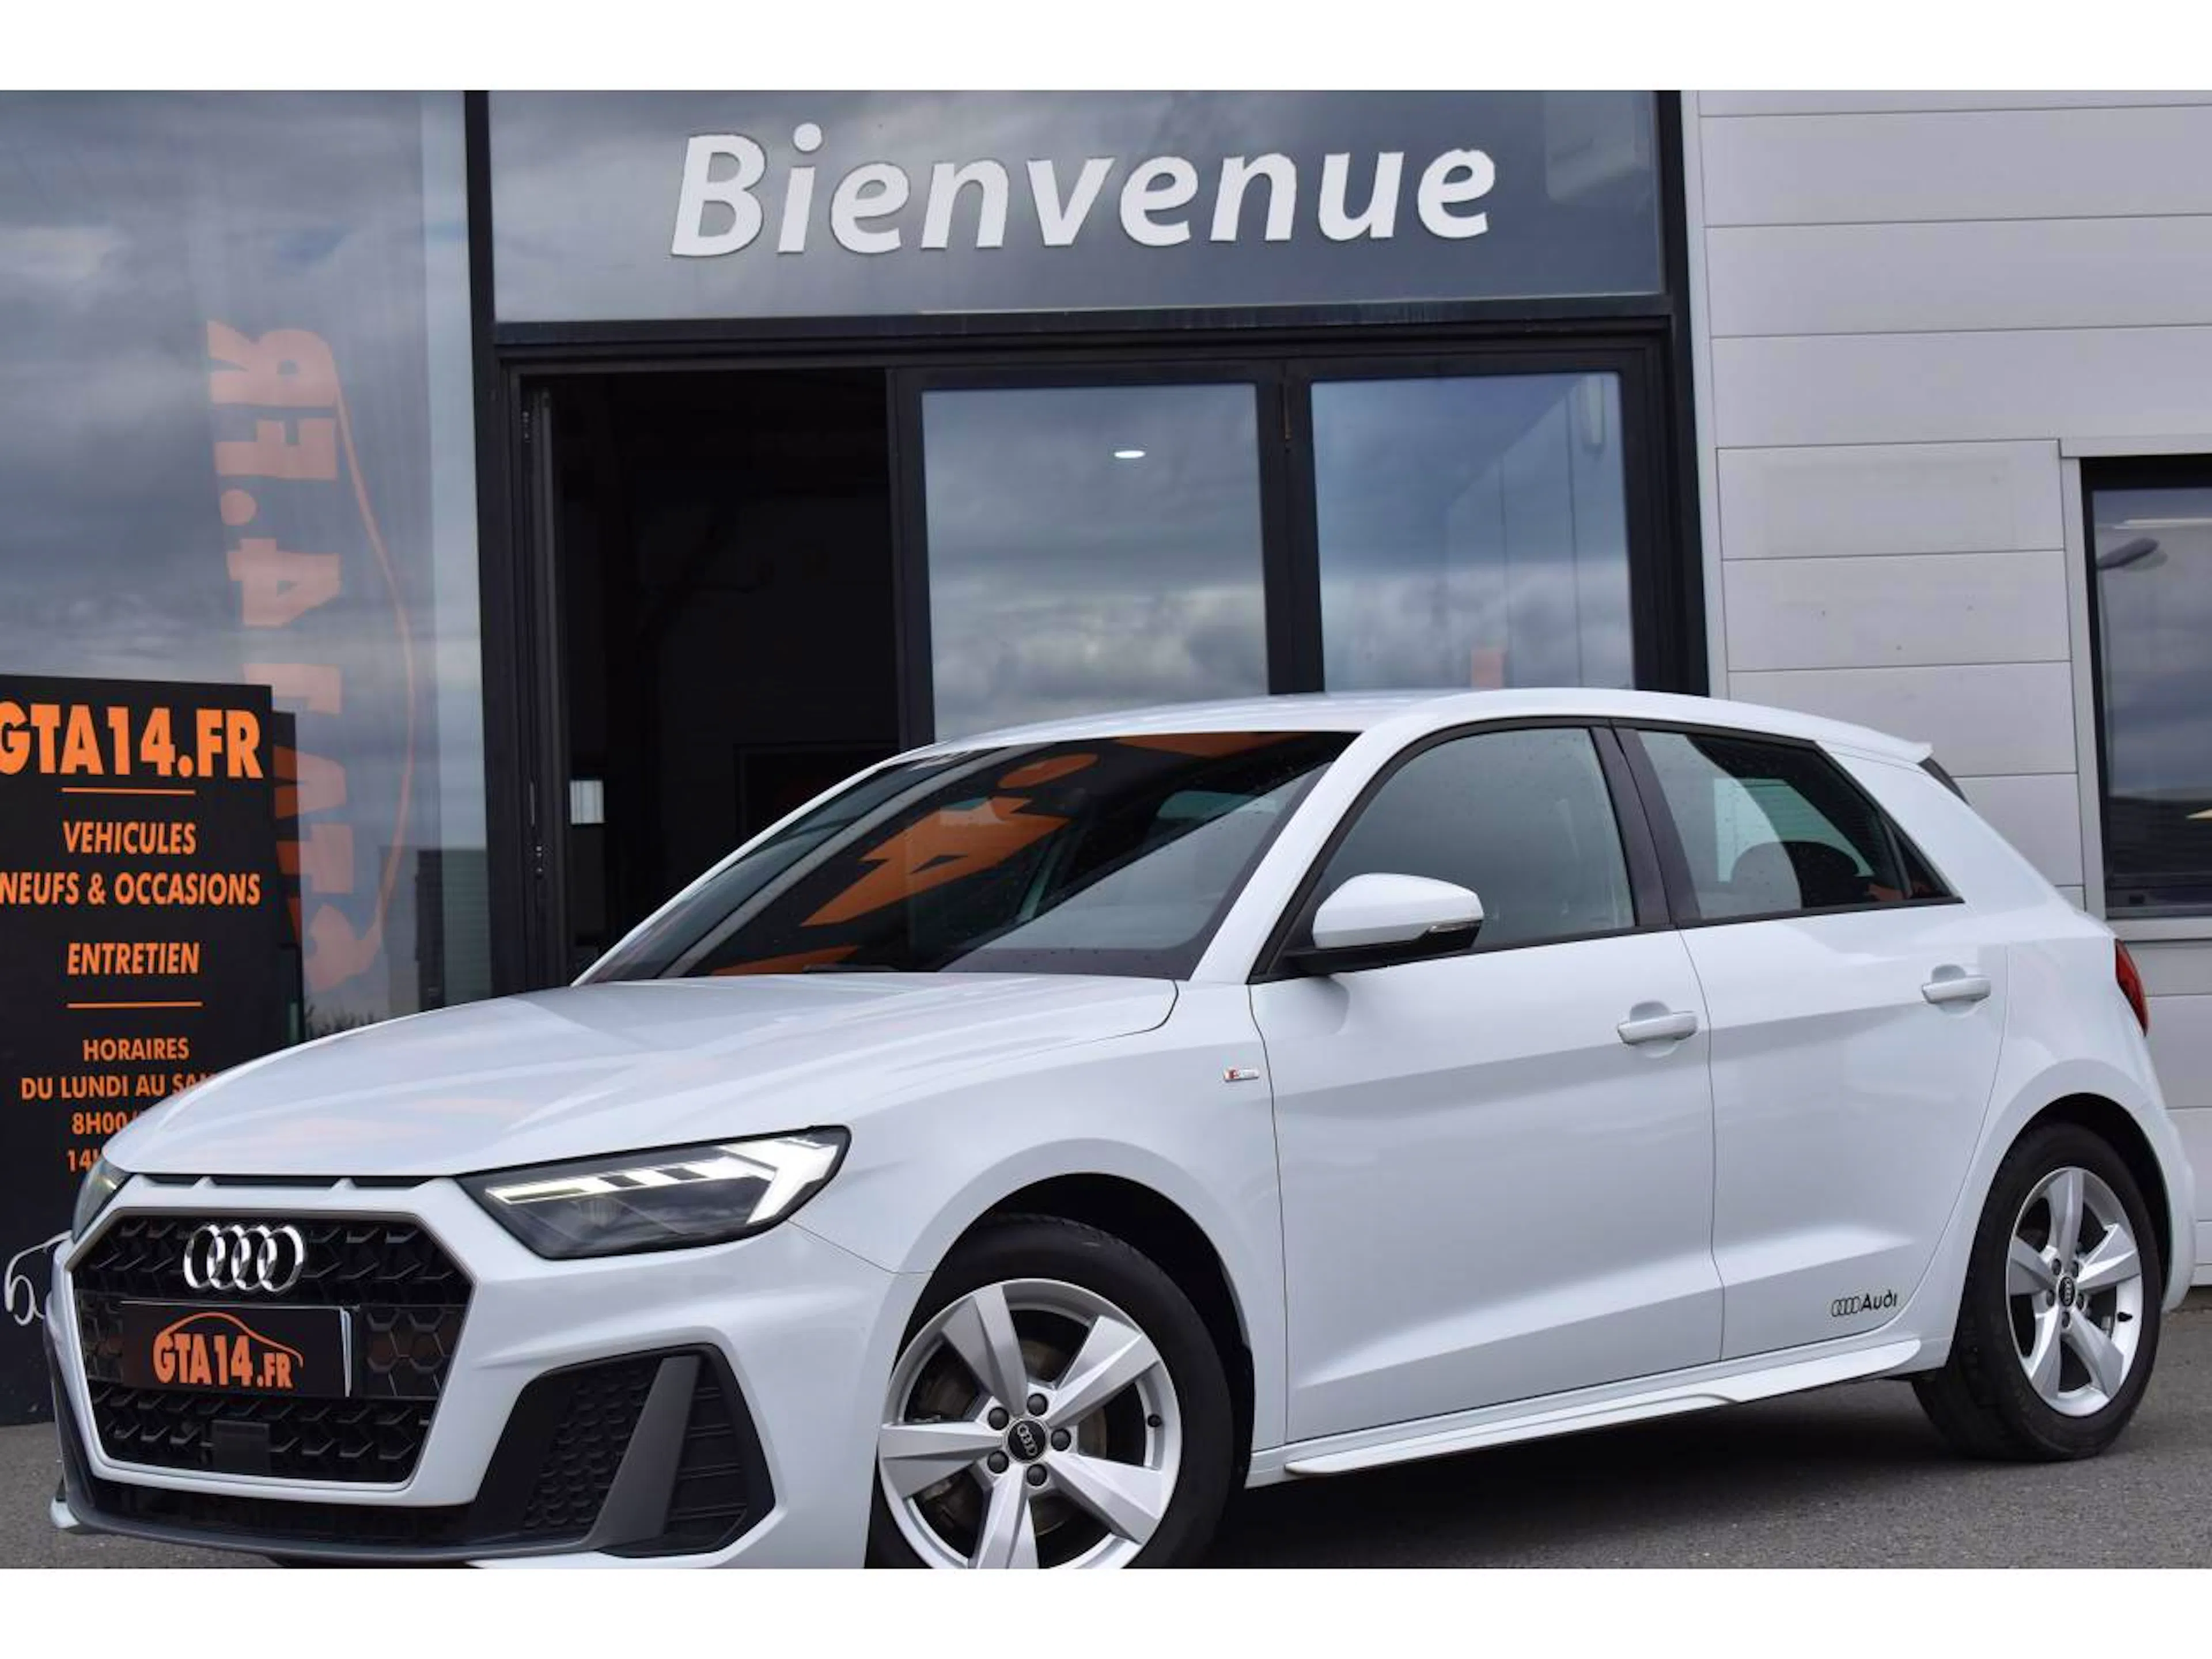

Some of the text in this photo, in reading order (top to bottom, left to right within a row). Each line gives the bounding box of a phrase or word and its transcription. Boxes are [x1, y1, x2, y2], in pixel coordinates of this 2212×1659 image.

[672, 123, 1495, 257] Bienvenue
[0, 700, 263, 779] GTA14.FR
[63, 821, 196, 855] VEHICULES
[0, 872, 260, 906] NEUFS & OCCASIONS
[67, 942, 200, 975] ENTRETIEN
[83, 1037, 190, 1062] HORAIRES
[21, 1077, 53, 1100] DU
[60, 1075, 128, 1099] LUNDI
[135, 1074, 165, 1096] AU
[153, 1331, 293, 1388] GTA14.FR
